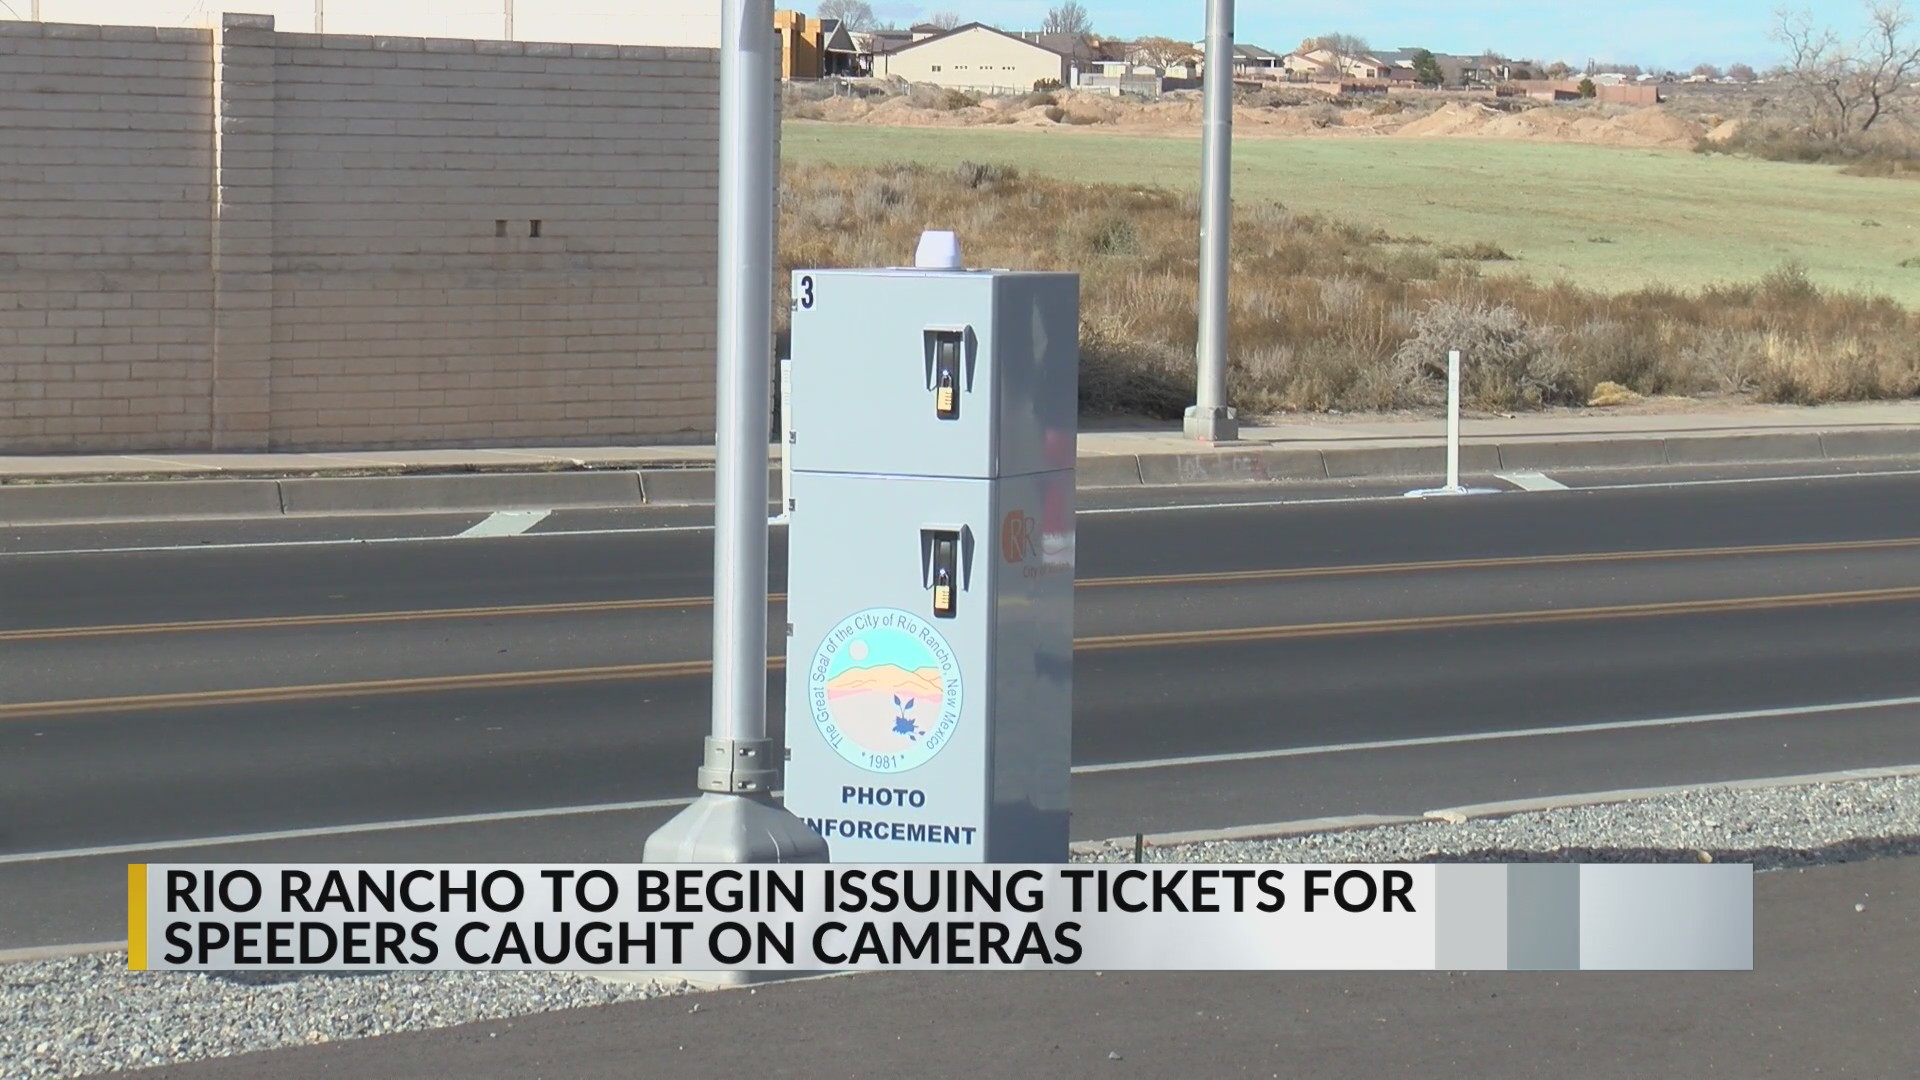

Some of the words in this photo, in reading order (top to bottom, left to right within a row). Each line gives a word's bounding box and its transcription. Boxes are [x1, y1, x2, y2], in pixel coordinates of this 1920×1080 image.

[801, 275, 814, 309] 3
[854, 614, 880, 631] City
[882, 613, 895, 626] of
[897, 614, 917, 634] Rio
[834, 623, 854, 642] the
[825, 638, 839, 654] of
[918, 627, 952, 676] Rancho,
[812, 653, 830, 682] Seal
[816, 685, 830, 723] Great
[946, 678, 958, 709] New
[825, 724, 844, 749] The
[926, 711, 957, 750] Mexico
[869, 753, 898, 770] 1981
[841, 785, 926, 808] PHOTO
[798, 817, 977, 845] NFORCEMENT
